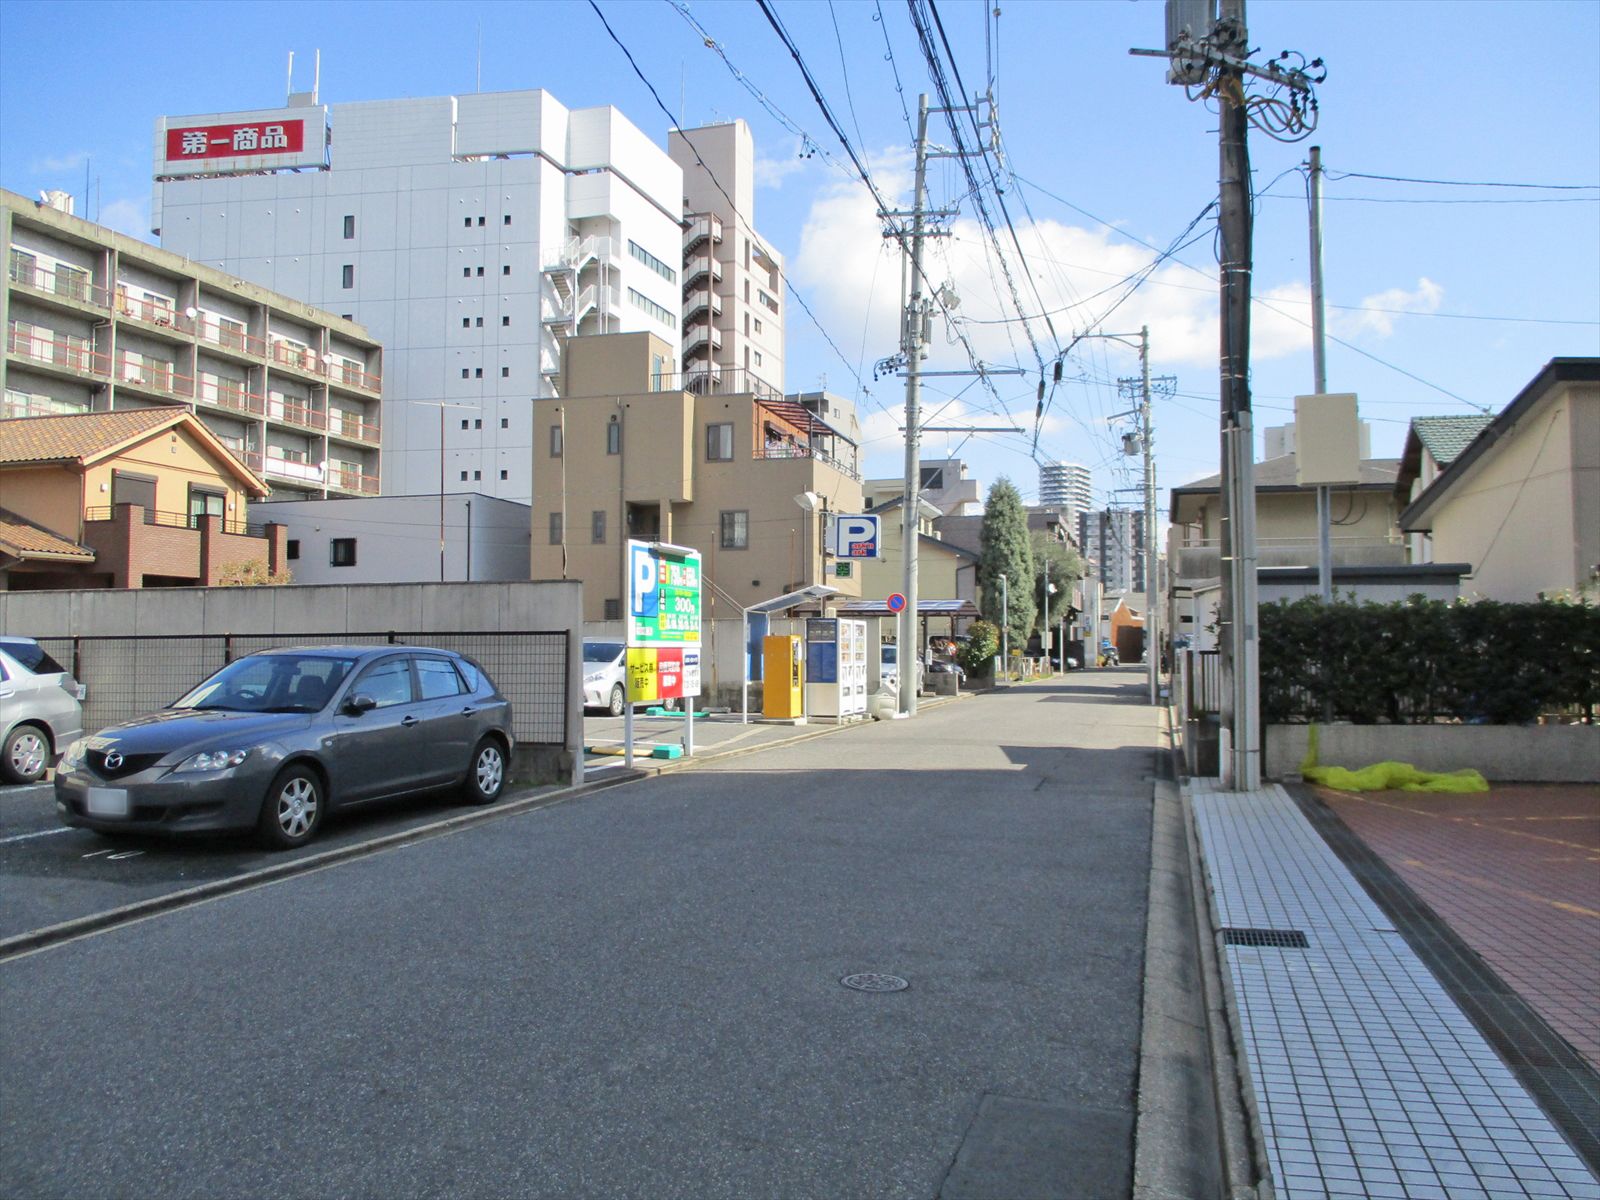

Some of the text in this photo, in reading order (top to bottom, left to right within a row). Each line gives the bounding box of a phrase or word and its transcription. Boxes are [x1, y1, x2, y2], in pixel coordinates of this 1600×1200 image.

[181, 125, 288, 155] 第一商品
[838, 518, 876, 556] P
[635, 550, 656, 612] P
